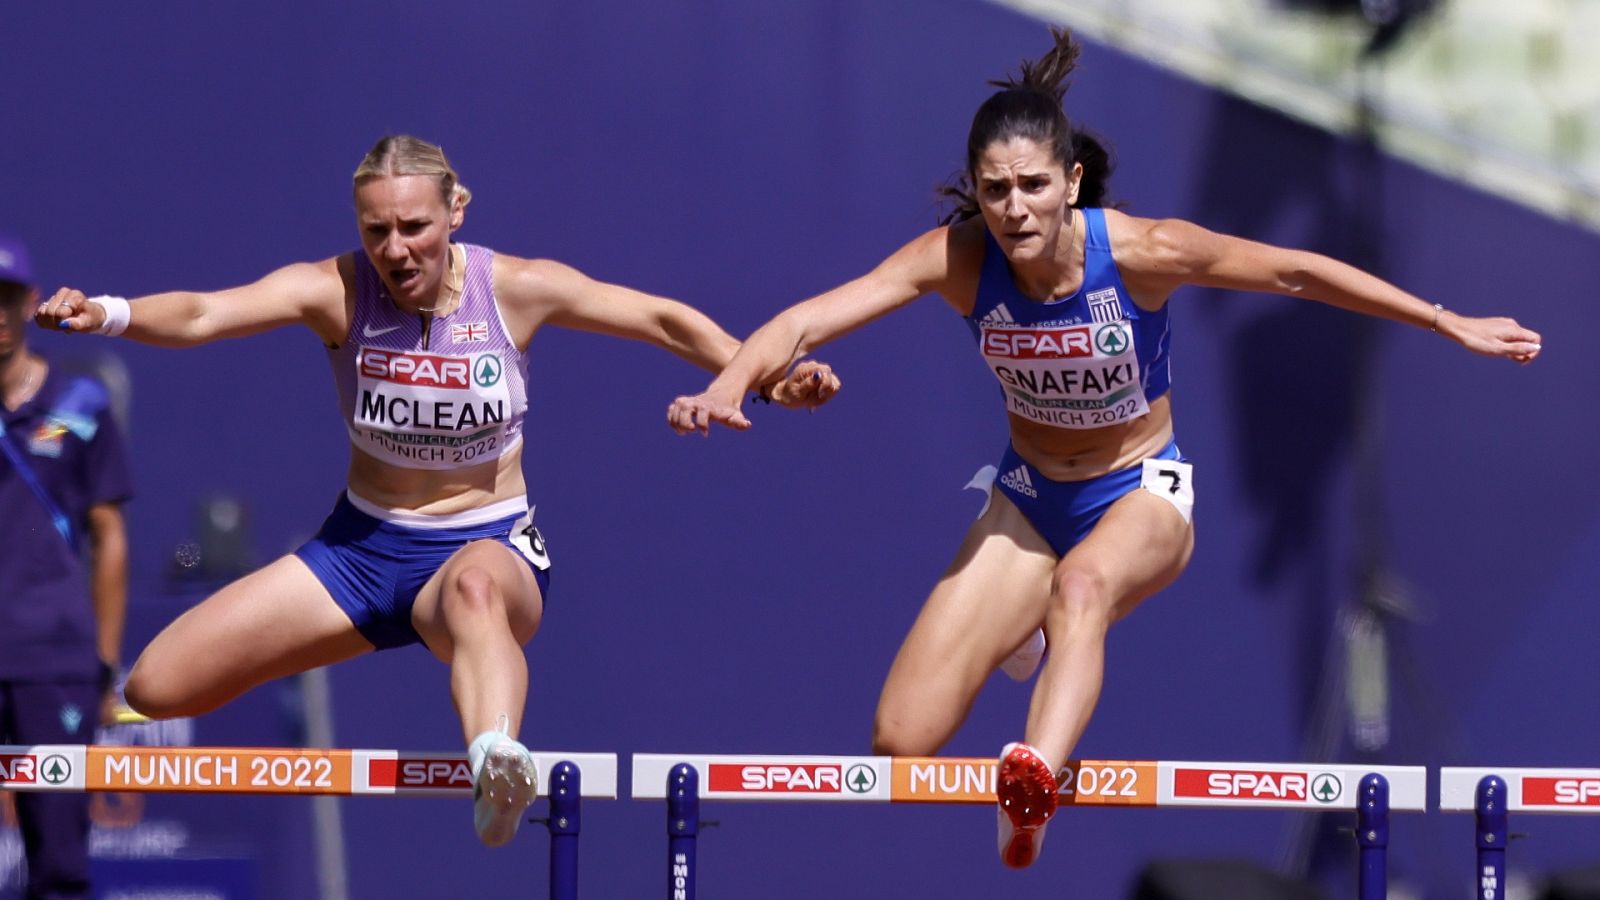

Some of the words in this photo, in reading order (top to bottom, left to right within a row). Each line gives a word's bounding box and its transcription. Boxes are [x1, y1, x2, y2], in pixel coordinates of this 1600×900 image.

[987, 331, 1091, 355] SPAR
[363, 353, 469, 385] SPAR
[995, 363, 1133, 394] GNAFAKI
[360, 391, 504, 430] MCLEAN
[1013, 398, 1085, 425] MUNICH
[1090, 399, 1139, 425] 2022
[370, 432, 445, 462] MUNICH
[452, 437, 497, 463] 2022
[1001, 475, 1038, 498] adidas
[1159, 470, 1181, 495] 7
[104, 755, 238, 786] MUNICH
[251, 757, 332, 787] 2022
[403, 762, 475, 785] SPA
[741, 766, 840, 790] SPAR
[910, 764, 998, 794] MUNI
[1058, 766, 1138, 796] 2022
[1207, 773, 1306, 798] SPAR
